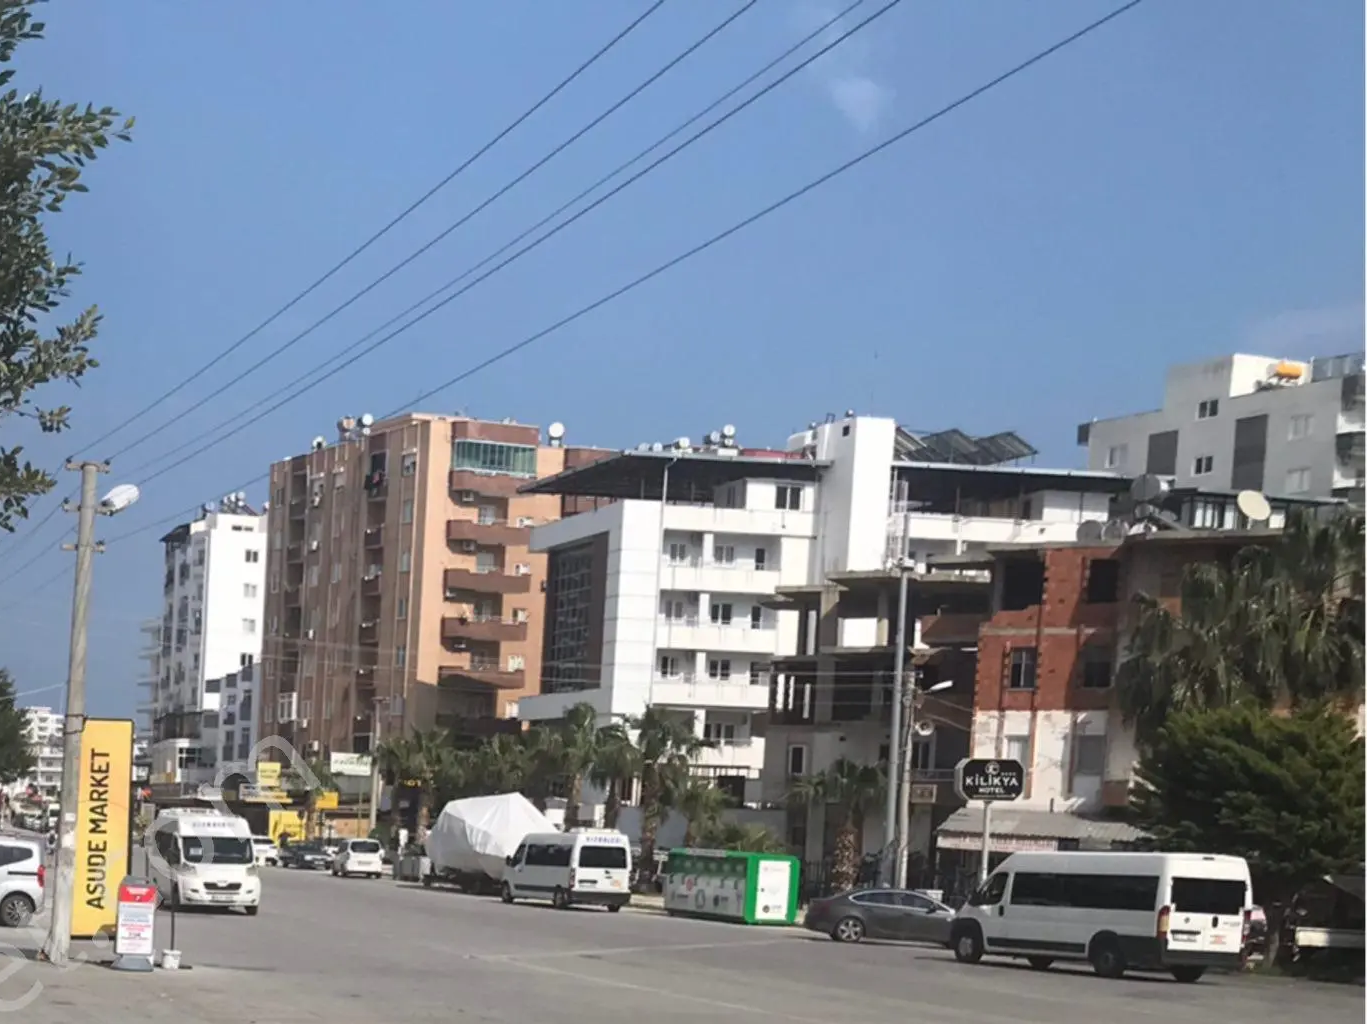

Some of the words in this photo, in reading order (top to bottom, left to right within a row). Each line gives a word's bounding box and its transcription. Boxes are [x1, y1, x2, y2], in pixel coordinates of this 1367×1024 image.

[88, 748, 110, 834] MARKET
[965, 773, 1019, 787] KİLİKYA
[86, 840, 108, 910] ASUDE
